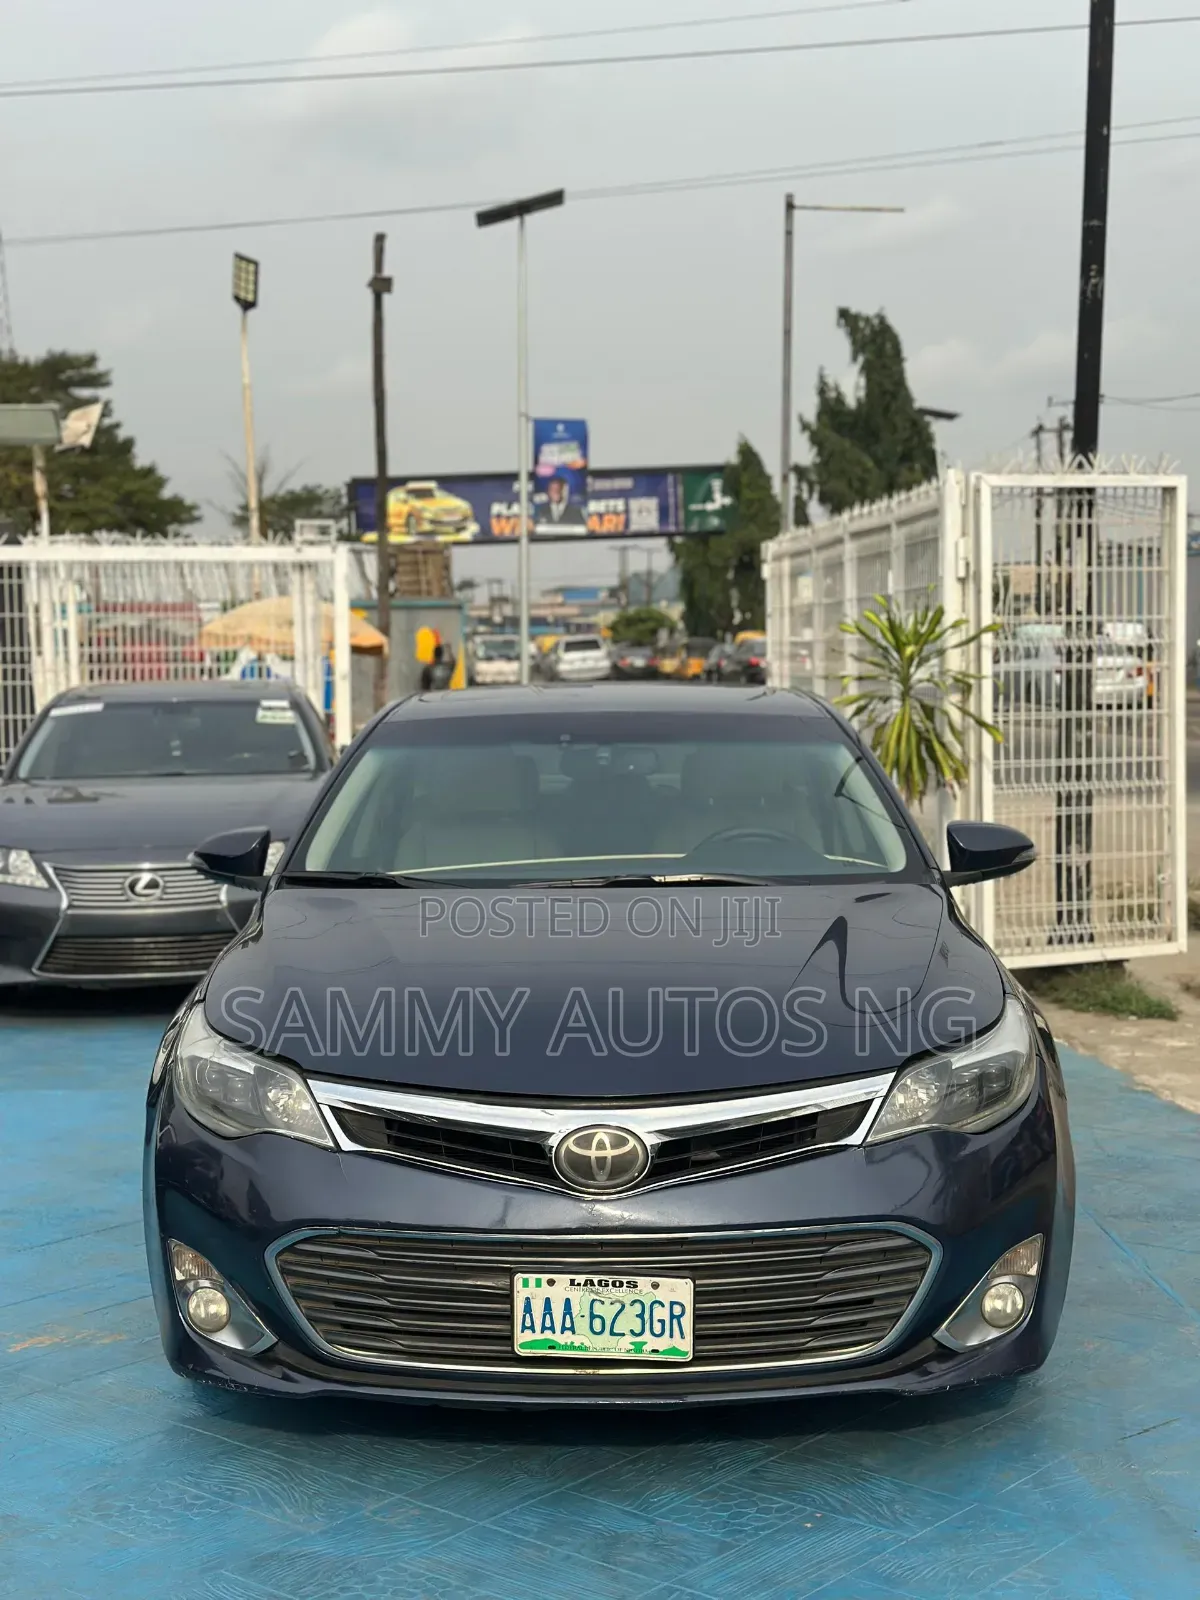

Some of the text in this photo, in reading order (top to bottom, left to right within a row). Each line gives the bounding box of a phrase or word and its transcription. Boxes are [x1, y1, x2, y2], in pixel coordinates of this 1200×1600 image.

[568, 1278, 639, 1289] LAGOS
[602, 1287, 644, 1295] EXCELLENCE
[520, 1296, 687, 1340] AAA-623GR
